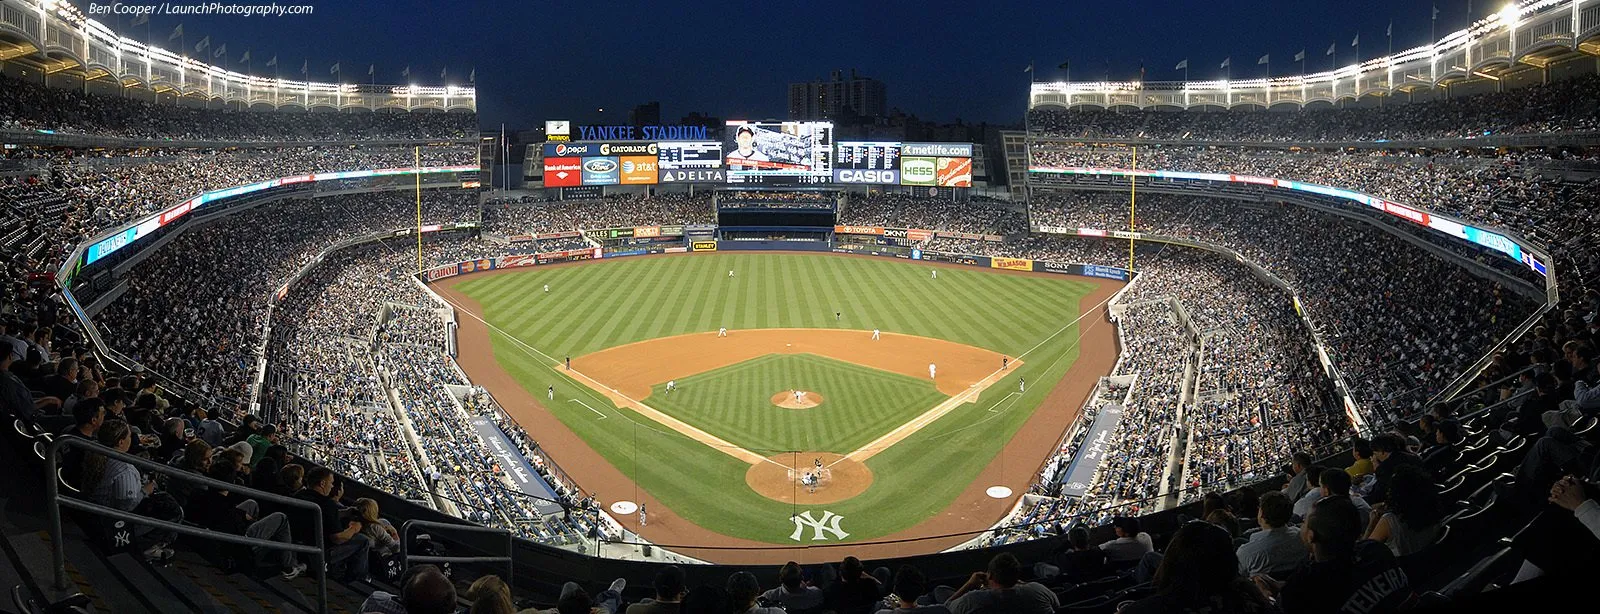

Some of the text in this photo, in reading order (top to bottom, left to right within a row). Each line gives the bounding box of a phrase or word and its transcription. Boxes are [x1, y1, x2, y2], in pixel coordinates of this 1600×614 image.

[578, 126, 707, 140] YANKEE STADIUM
[567, 145, 588, 154] pepsi
[913, 145, 970, 155] metlife.com
[591, 160, 610, 171] Ford
[636, 161, 656, 171] at&t
[678, 171, 723, 181] DELTA
[904, 167, 933, 175] HESS
[839, 170, 895, 183] CASIO
[428, 265, 458, 280] Canon
[1340, 567, 1409, 614] TEIXEIRA
